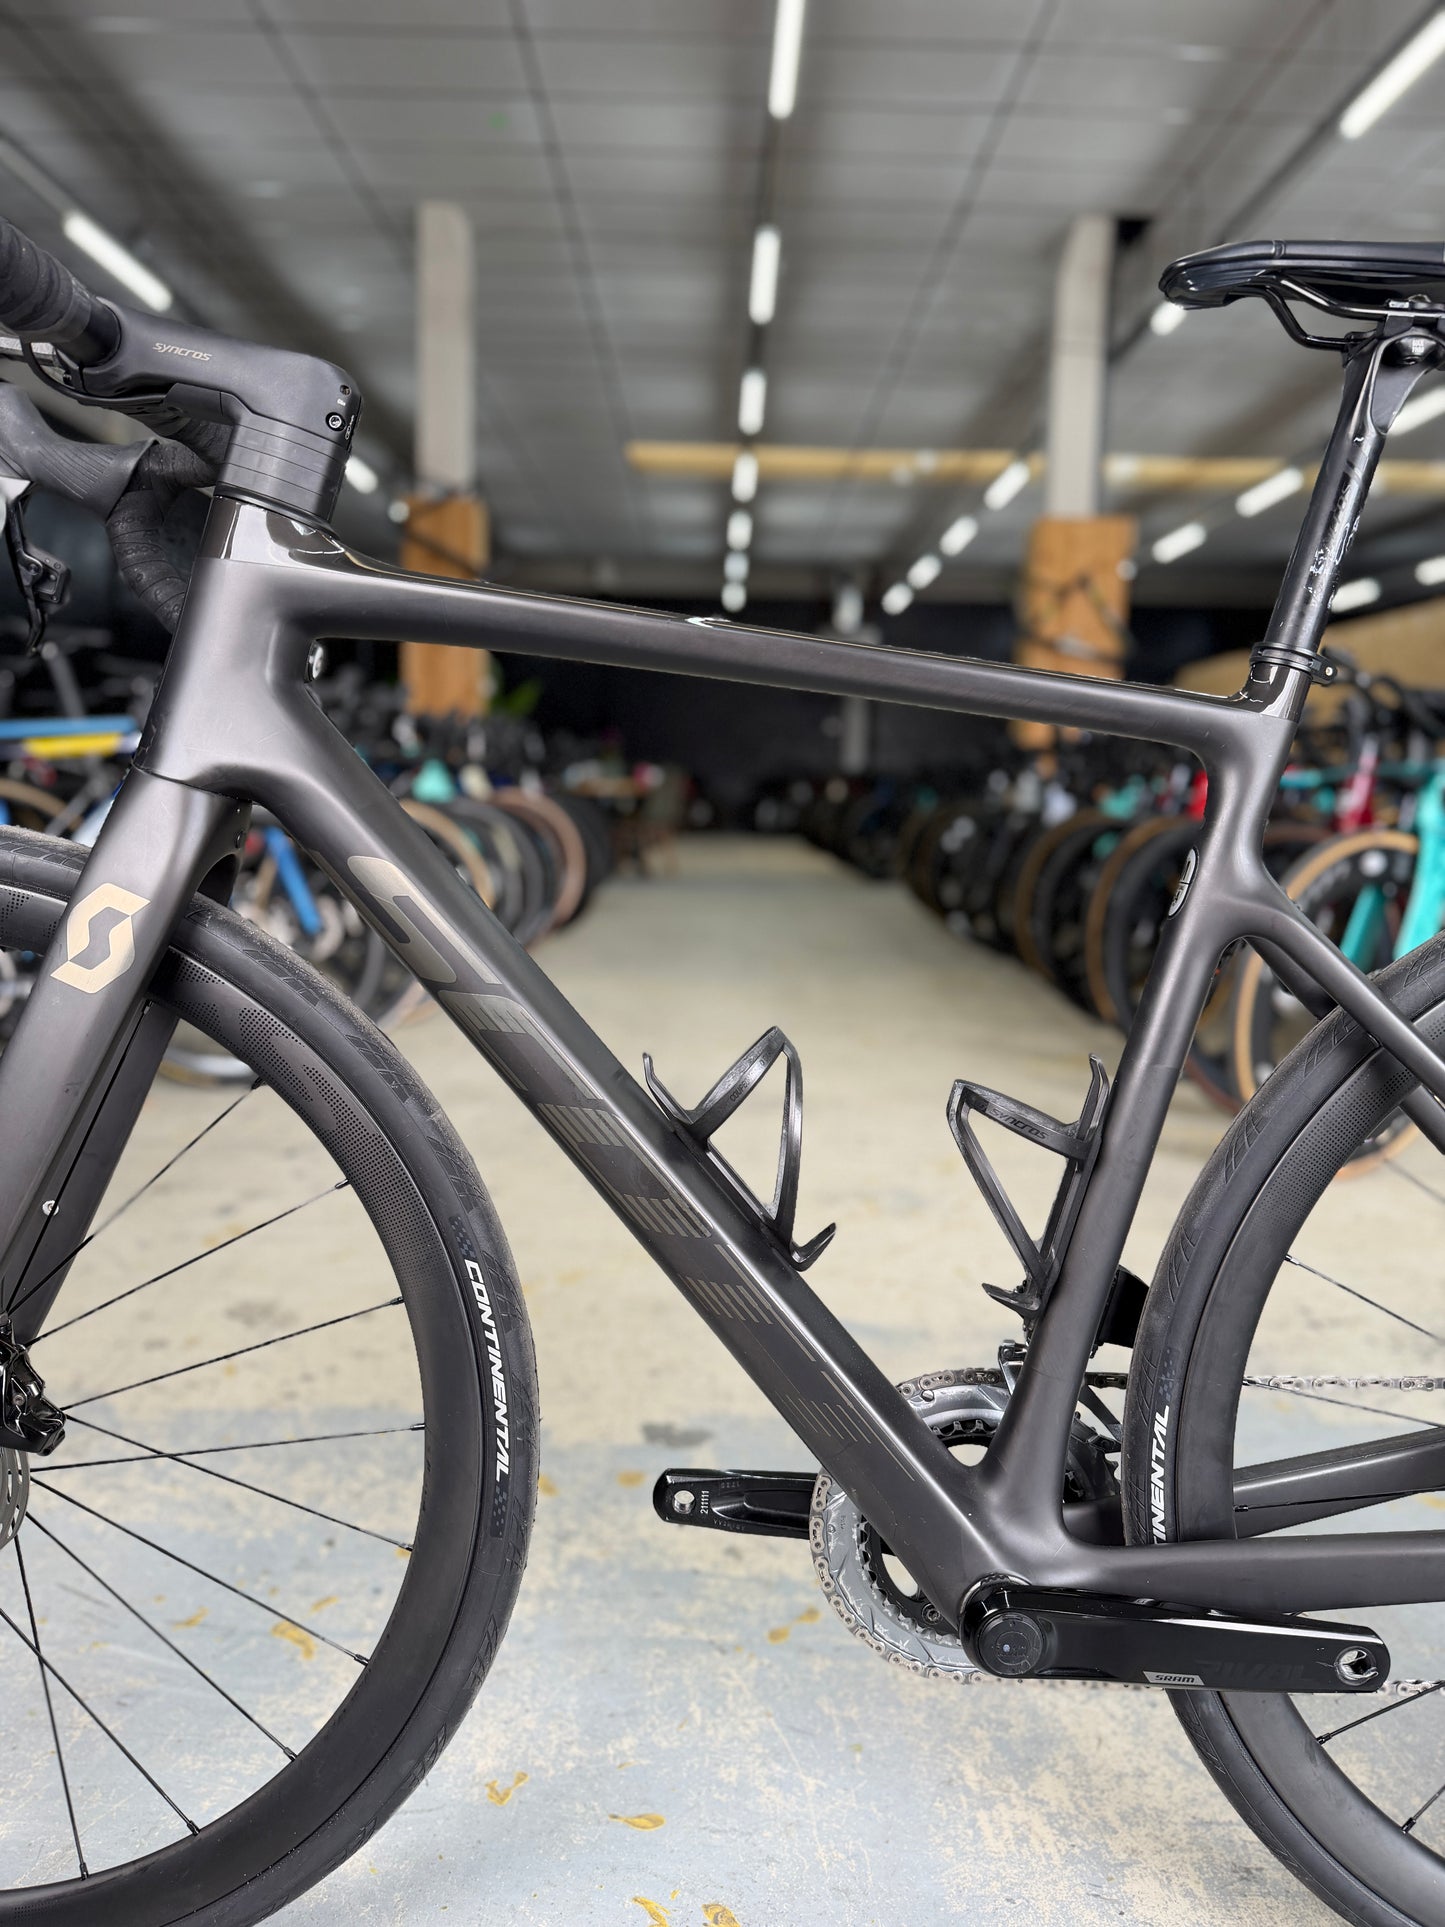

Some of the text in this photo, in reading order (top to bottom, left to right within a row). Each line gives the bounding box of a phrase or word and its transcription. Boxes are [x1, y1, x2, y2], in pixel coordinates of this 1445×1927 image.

[152, 342, 213, 361] syncros
[989, 1107, 1049, 1140] syncros
[464, 1258, 510, 1482] CONTINENTAL
[1154, 1674, 1195, 1684] SRAM
